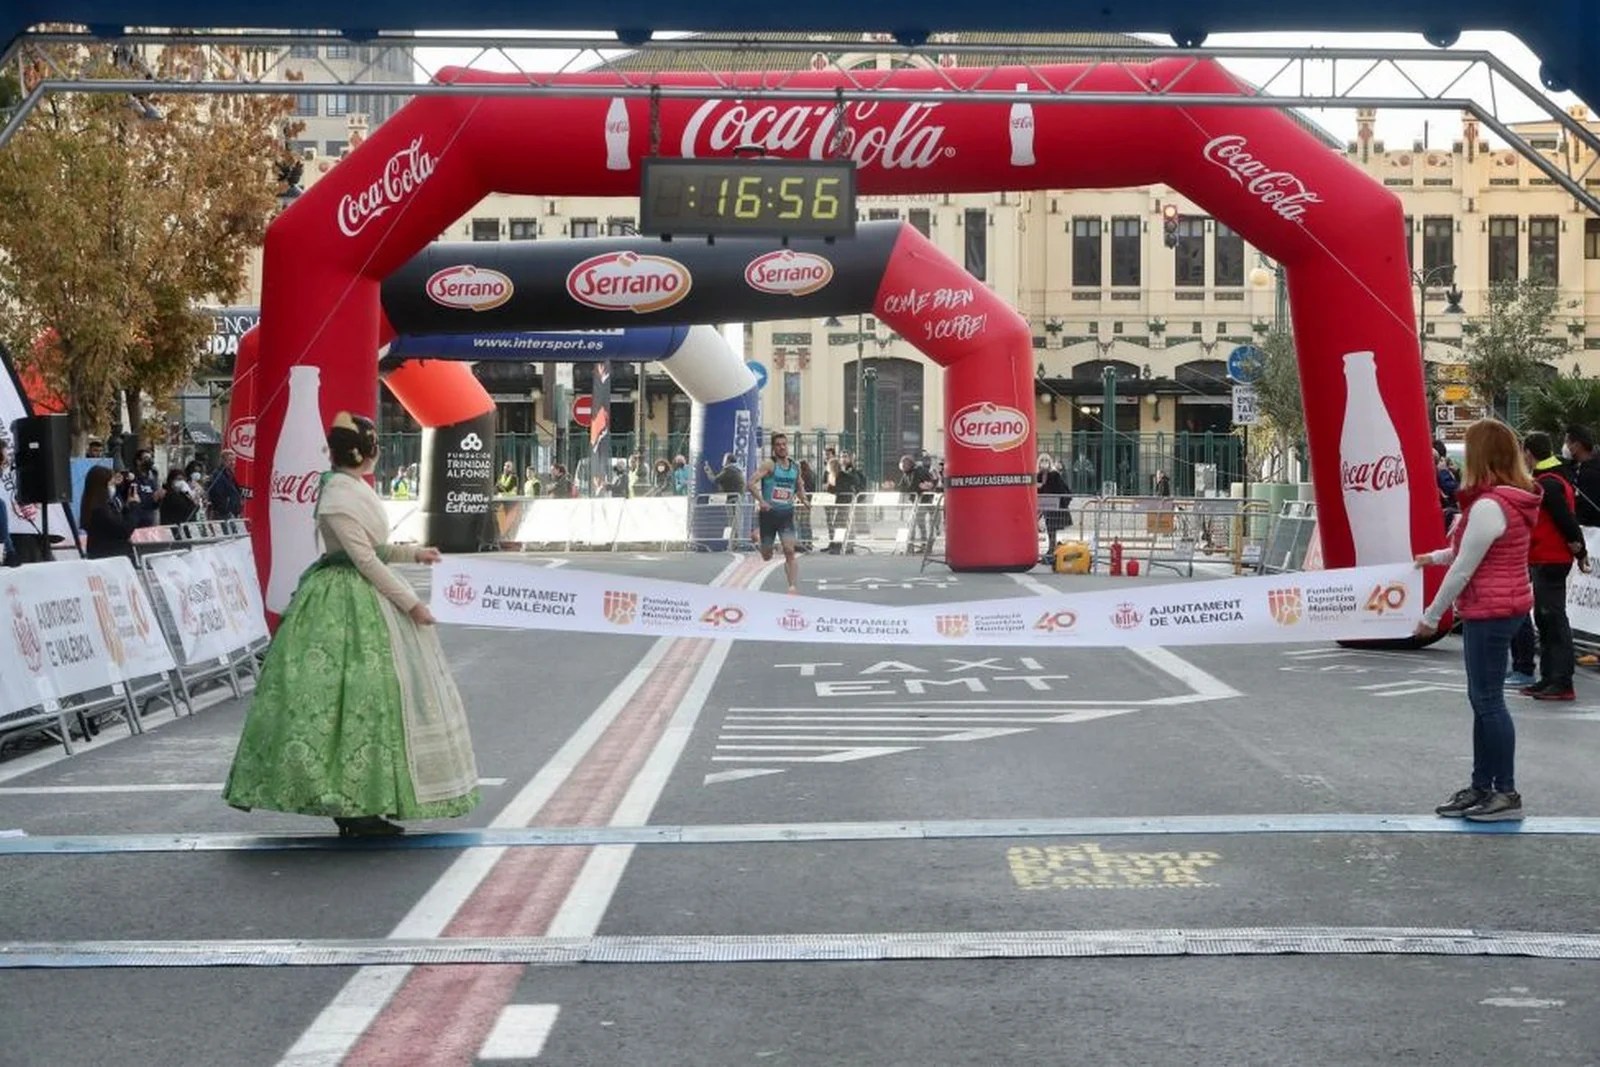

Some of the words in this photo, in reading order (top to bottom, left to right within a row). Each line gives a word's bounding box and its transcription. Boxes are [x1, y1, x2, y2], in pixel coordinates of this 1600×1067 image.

[755, 263, 824, 283] Serrano
[435, 278, 505, 297] Serrano
[581, 269, 678, 295] Serrano
[883, 288, 930, 318] COME
[933, 288, 974, 308] BIEN
[473, 337, 604, 352] www.intersport.es
[958, 417, 1024, 437] Serrano
[447, 459, 491, 469] TRINIDAD
[446, 469, 490, 478] ALFONSO
[447, 491, 483, 502] Cultura
[484, 585, 578, 603] AJUNTAMENT
[481, 598, 500, 609] DE
[1150, 599, 1242, 615] AJUNTAMENT
[1308, 603, 1357, 614] Municipal
[816, 616, 908, 626] AJUNTAMENT
[1150, 617, 1168, 627] DE
[816, 625, 835, 633] DE
[774, 657, 1045, 676] TAXI
[814, 675, 1069, 697] EMT
